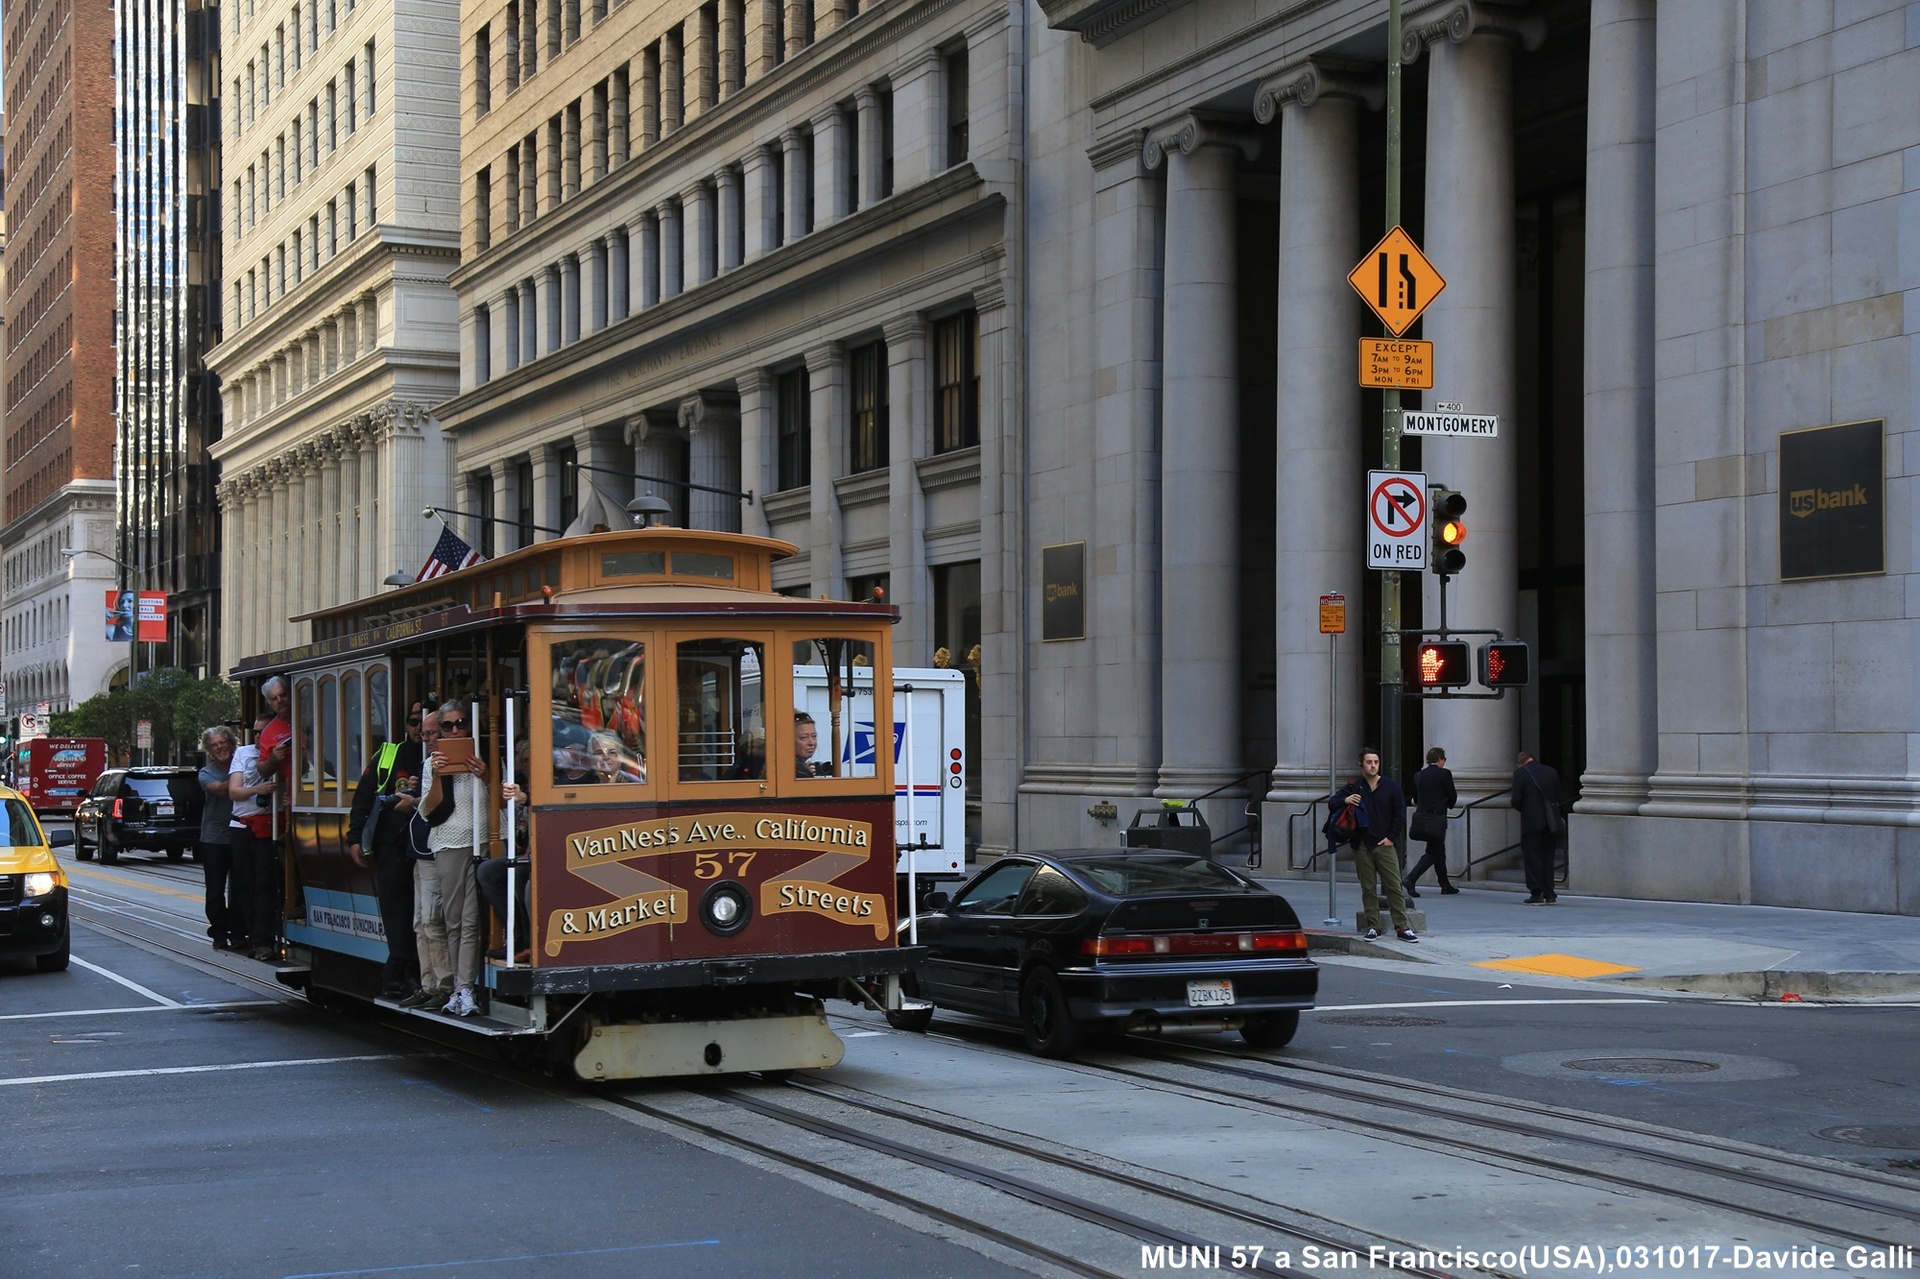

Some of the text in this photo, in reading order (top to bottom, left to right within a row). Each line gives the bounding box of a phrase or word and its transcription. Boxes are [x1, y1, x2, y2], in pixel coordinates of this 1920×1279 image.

[1375, 343, 1419, 354] EXCEPT
[1371, 354, 1389, 363] 7AM
[1404, 354, 1423, 364] 9AM
[1371, 365, 1389, 374] 3PM
[1404, 366, 1423, 376] 6PM
[1446, 403, 1462, 411] 400
[1406, 416, 1495, 434] MONTGOMERY
[1373, 543, 1421, 560] ON RED
[385, 621, 414, 640] CALIFORNIA
[572, 836, 617, 859] Van
[619, 827, 680, 851] Ness
[755, 819, 867, 847] California
[695, 851, 757, 880] 57
[780, 885, 873, 918] Streets
[313, 909, 323, 923] SAN
[324, 911, 350, 929] FRANCISCO
[352, 917, 378, 935] MUNICIPAL
[561, 893, 676, 934] & Market
